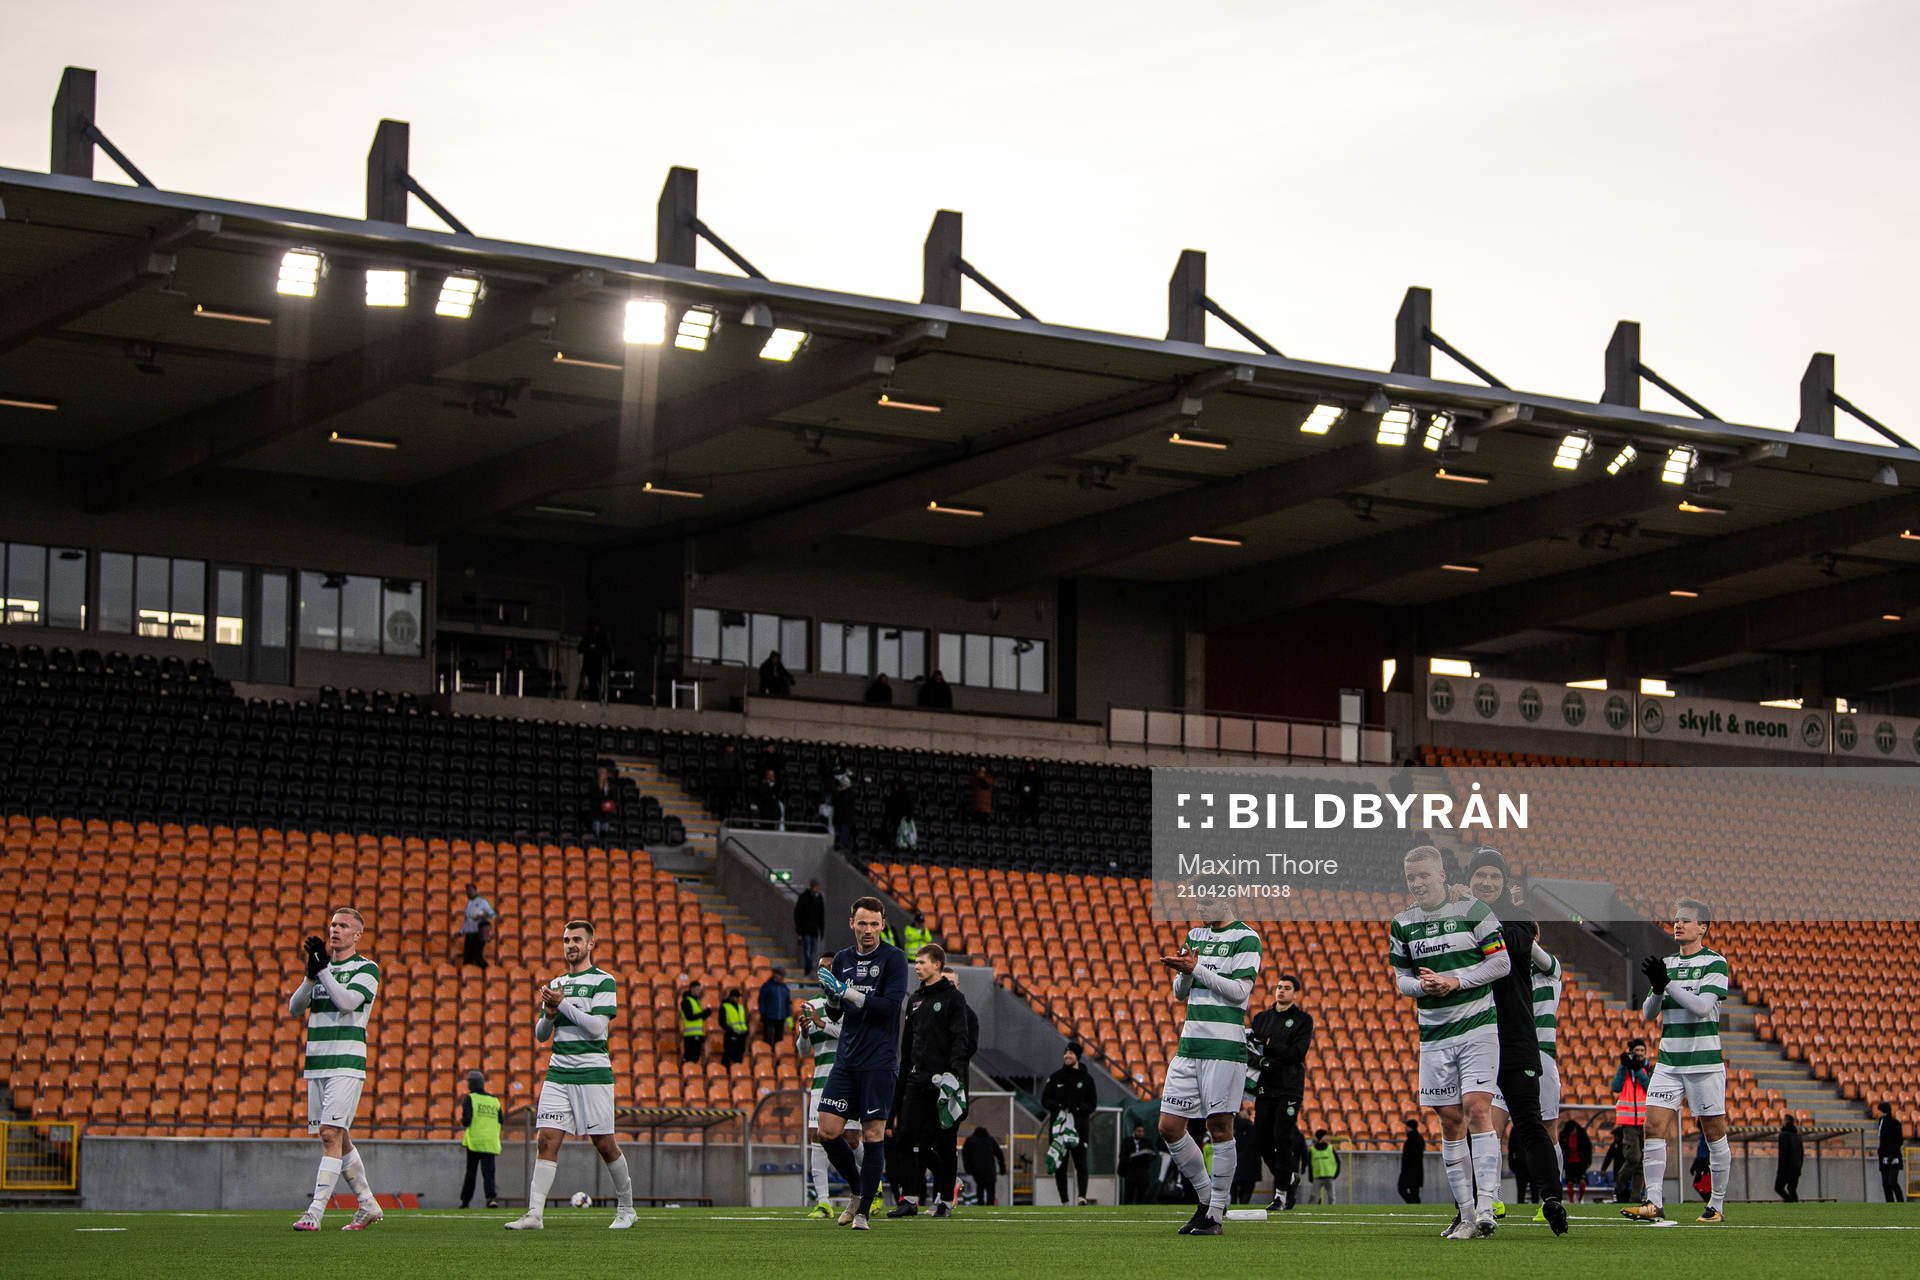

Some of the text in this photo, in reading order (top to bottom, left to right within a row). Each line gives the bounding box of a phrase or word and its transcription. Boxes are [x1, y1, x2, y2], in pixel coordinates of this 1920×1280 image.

[1679, 708, 1787, 738] skylt & neon
[1420, 1086, 1456, 1096] ALKEMIT
